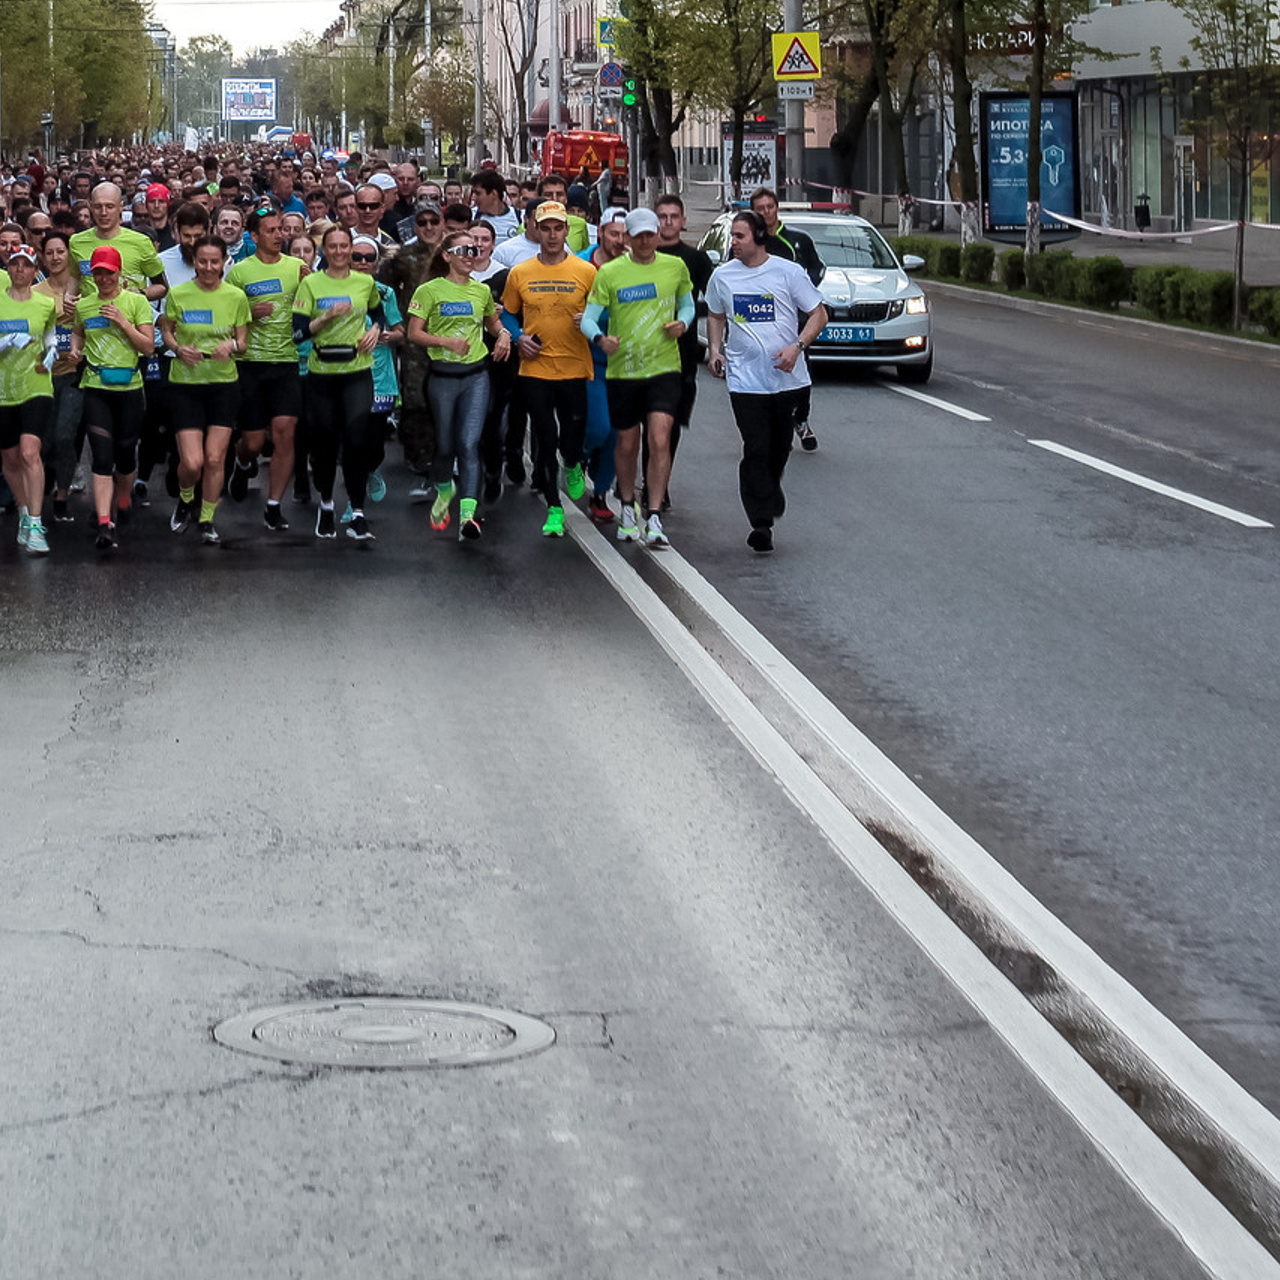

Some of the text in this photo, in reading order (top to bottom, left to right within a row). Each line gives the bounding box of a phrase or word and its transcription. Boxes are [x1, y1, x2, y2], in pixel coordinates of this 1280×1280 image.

[990, 120, 1054, 131] ИПОТА
[1000, 146, 1028, 165] 5,3
[748, 304, 774, 313] 1042
[827, 328, 853, 340] 3033
